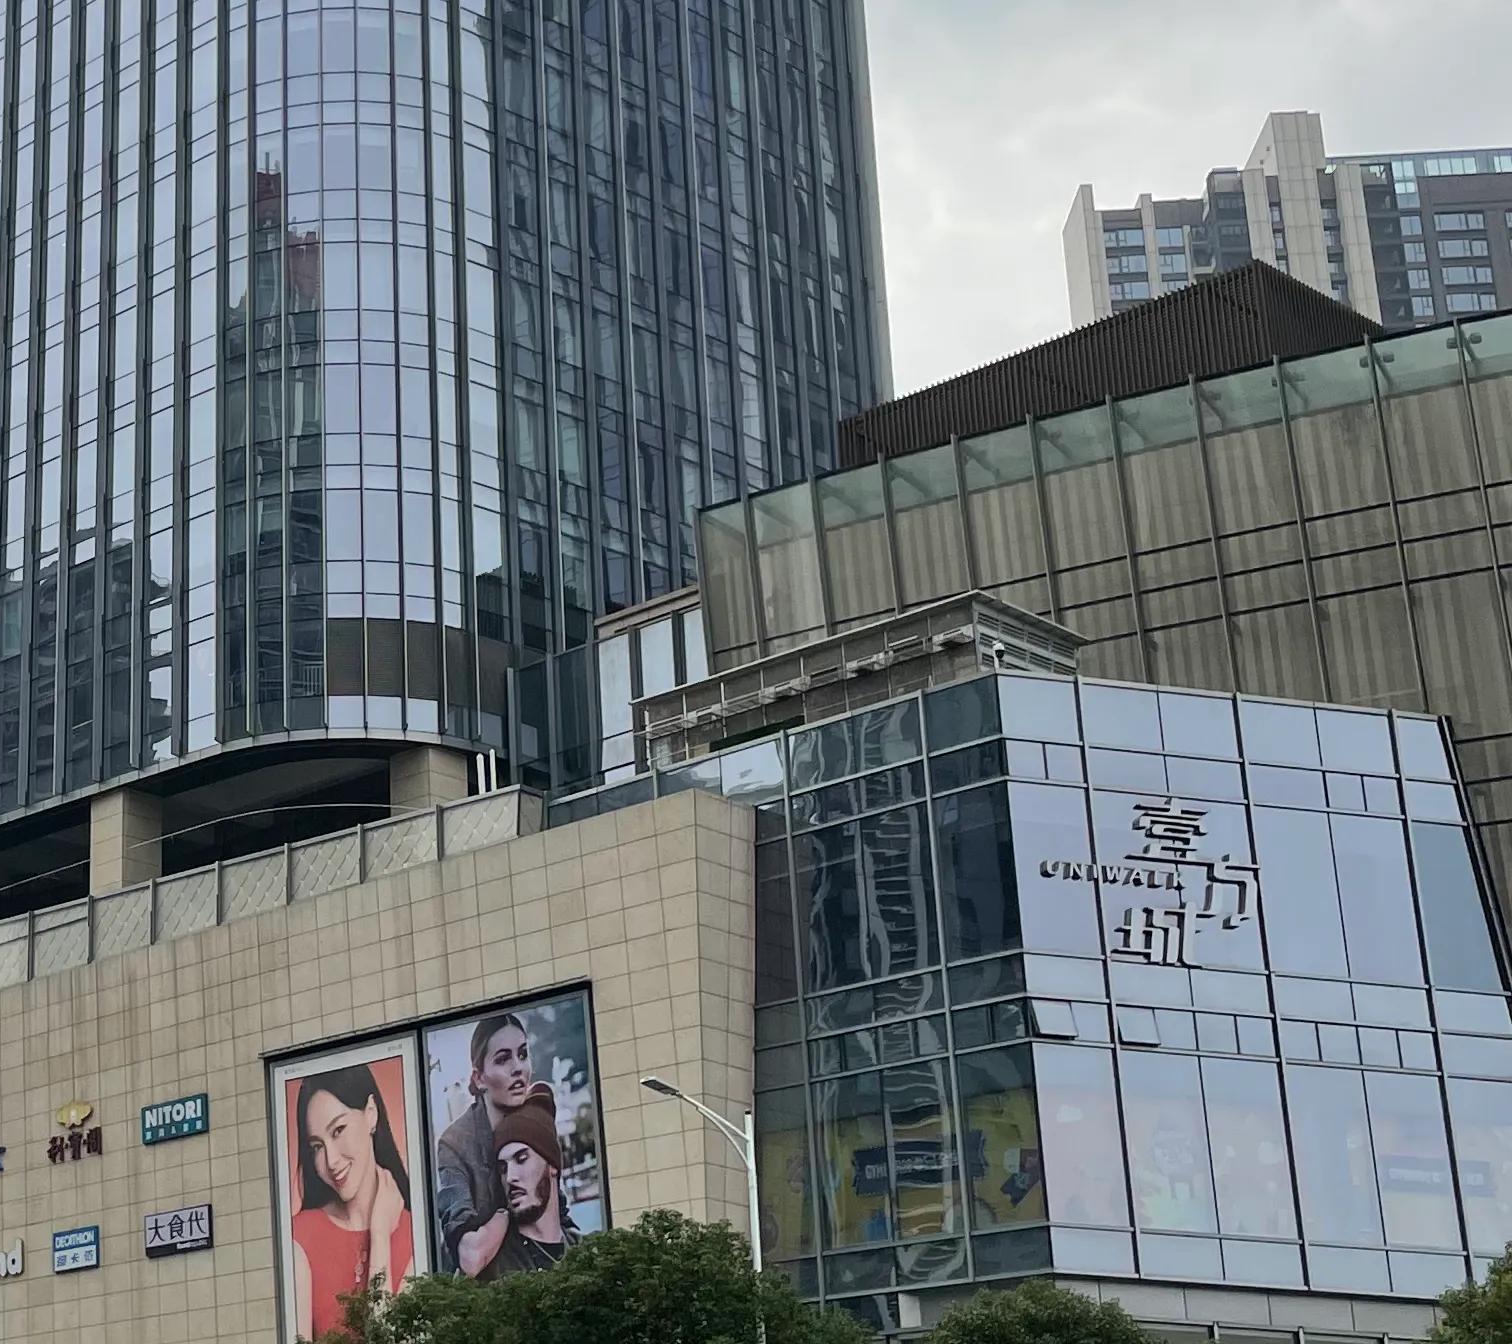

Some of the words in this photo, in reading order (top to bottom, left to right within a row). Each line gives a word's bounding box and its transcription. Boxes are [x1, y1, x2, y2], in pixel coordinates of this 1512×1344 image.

[1039, 859, 1187, 891] UNIWALK
[145, 1098, 202, 1129] NITORI
[147, 1210, 207, 1245] 大食代
